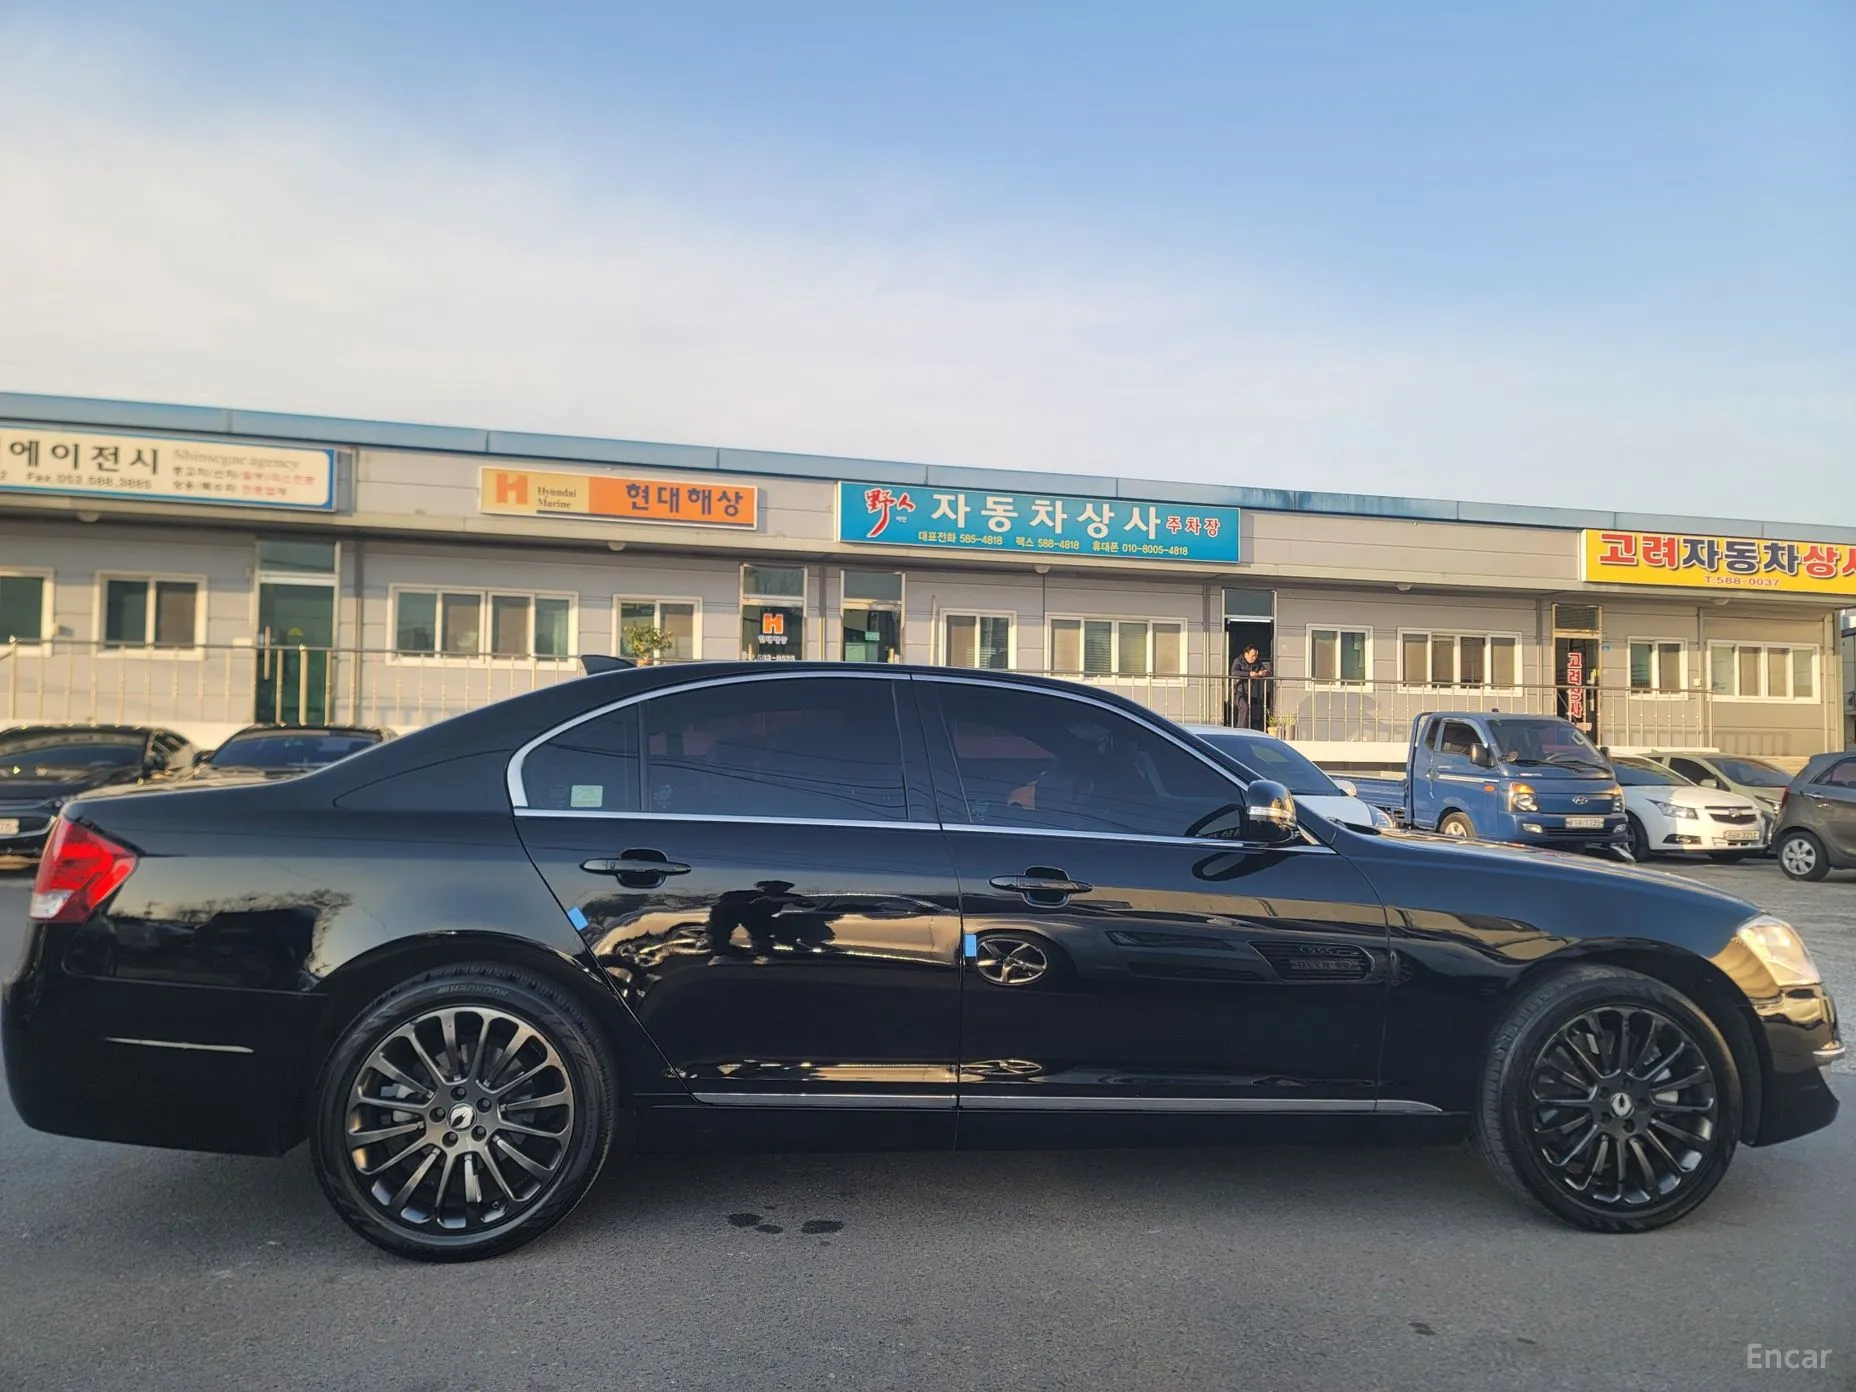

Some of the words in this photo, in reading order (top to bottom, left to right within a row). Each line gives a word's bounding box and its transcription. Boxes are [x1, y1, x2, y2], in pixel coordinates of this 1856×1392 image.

[537, 486, 577, 499] Hyundai
[537, 498, 572, 509] Marine
[625, 483, 744, 517] 현대해상
[930, 493, 1161, 540] 자동차상사
[1166, 515, 1220, 537] 주차장
[918, 531, 956, 543] 대표전화
[1015, 536, 1034, 548] 팩스
[1092, 540, 1119, 553] 휴대폰
